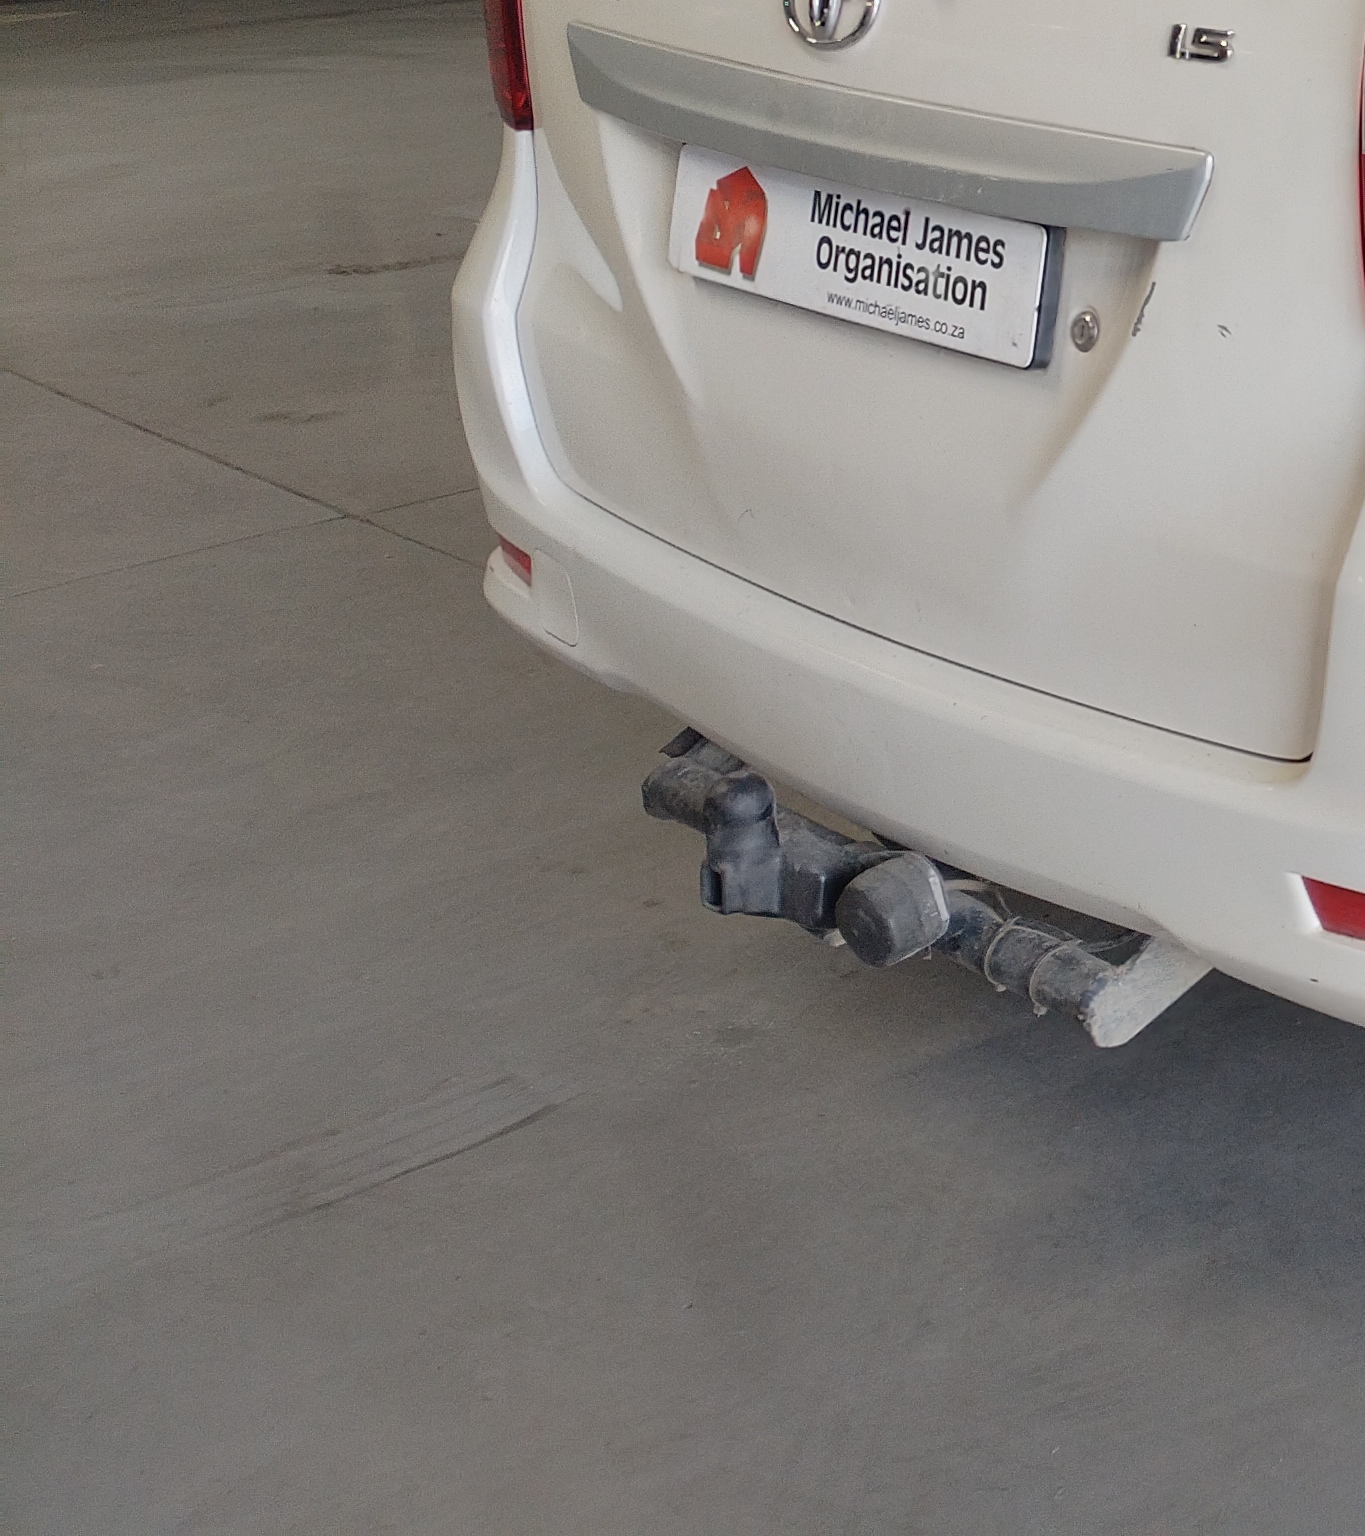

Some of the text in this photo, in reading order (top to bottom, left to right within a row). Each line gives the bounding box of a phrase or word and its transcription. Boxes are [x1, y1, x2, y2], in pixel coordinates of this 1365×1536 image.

[810, 189, 1006, 270] Michael James
[815, 235, 988, 312] Organisation
[826, 291, 966, 340] www.michaeljames.co.za
